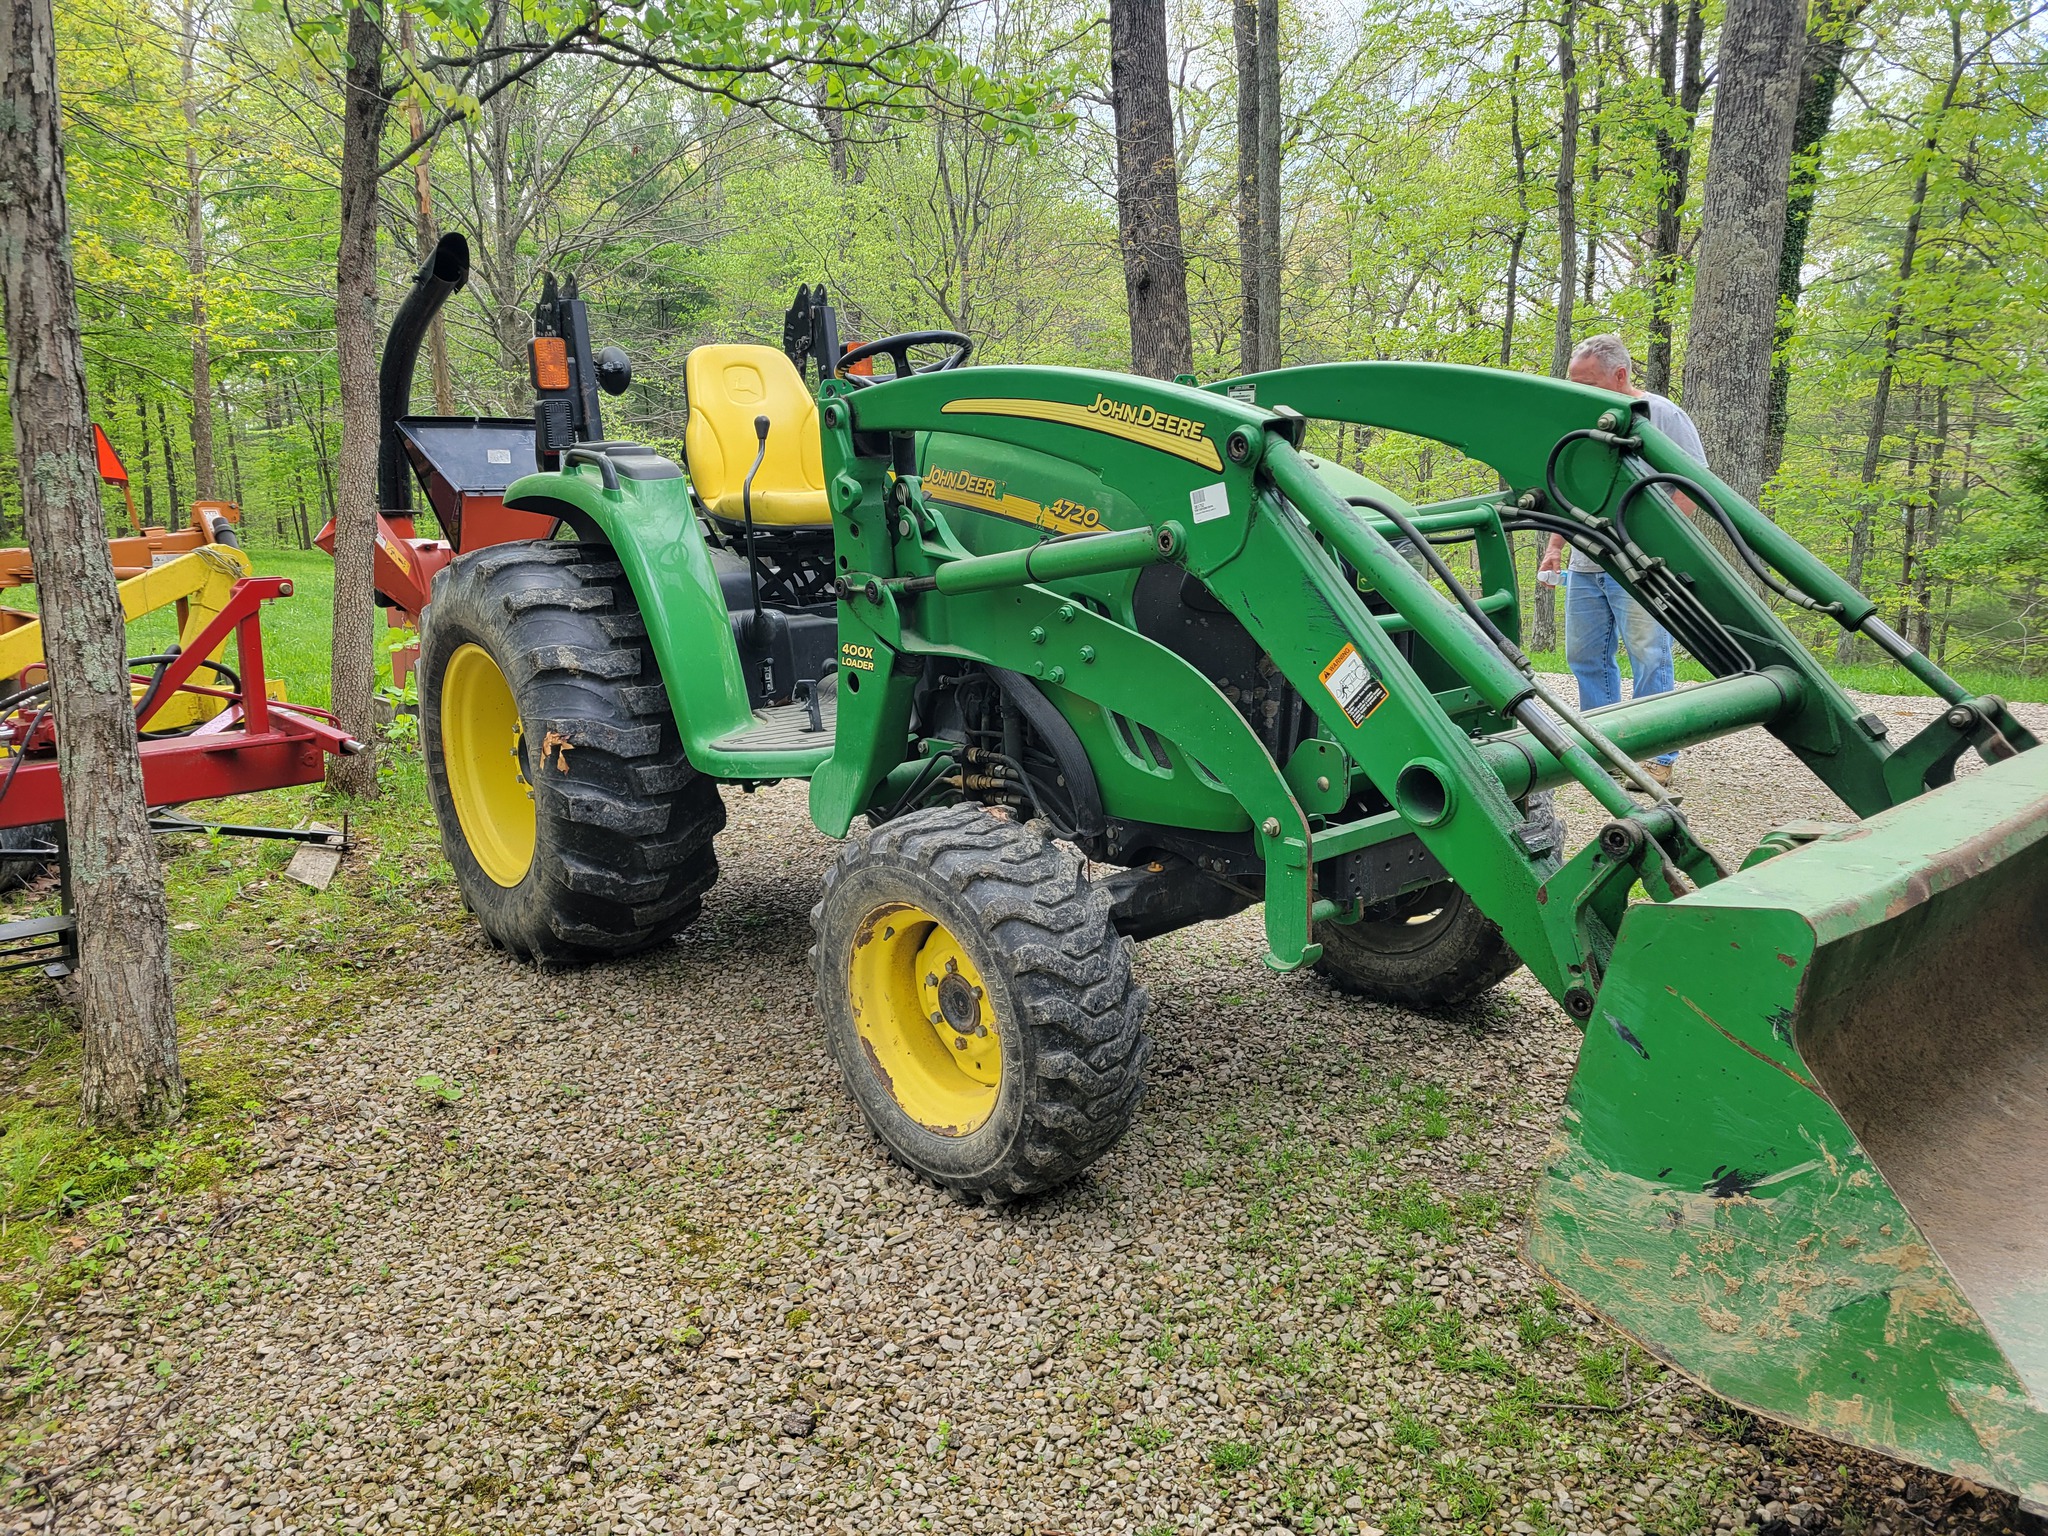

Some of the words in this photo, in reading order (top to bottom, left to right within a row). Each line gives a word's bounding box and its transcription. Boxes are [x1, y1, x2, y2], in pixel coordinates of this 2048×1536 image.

[1087, 393, 1138, 423] JOHN
[1137, 404, 1206, 440] DEERE
[924, 464, 958, 488] JOHN
[956, 469, 1003, 498] DEER
[1052, 498, 1099, 527] 4720
[842, 643, 874, 659] 400X
[842, 656, 874, 671] LOADER
[1329, 647, 1351, 672] WARNING
